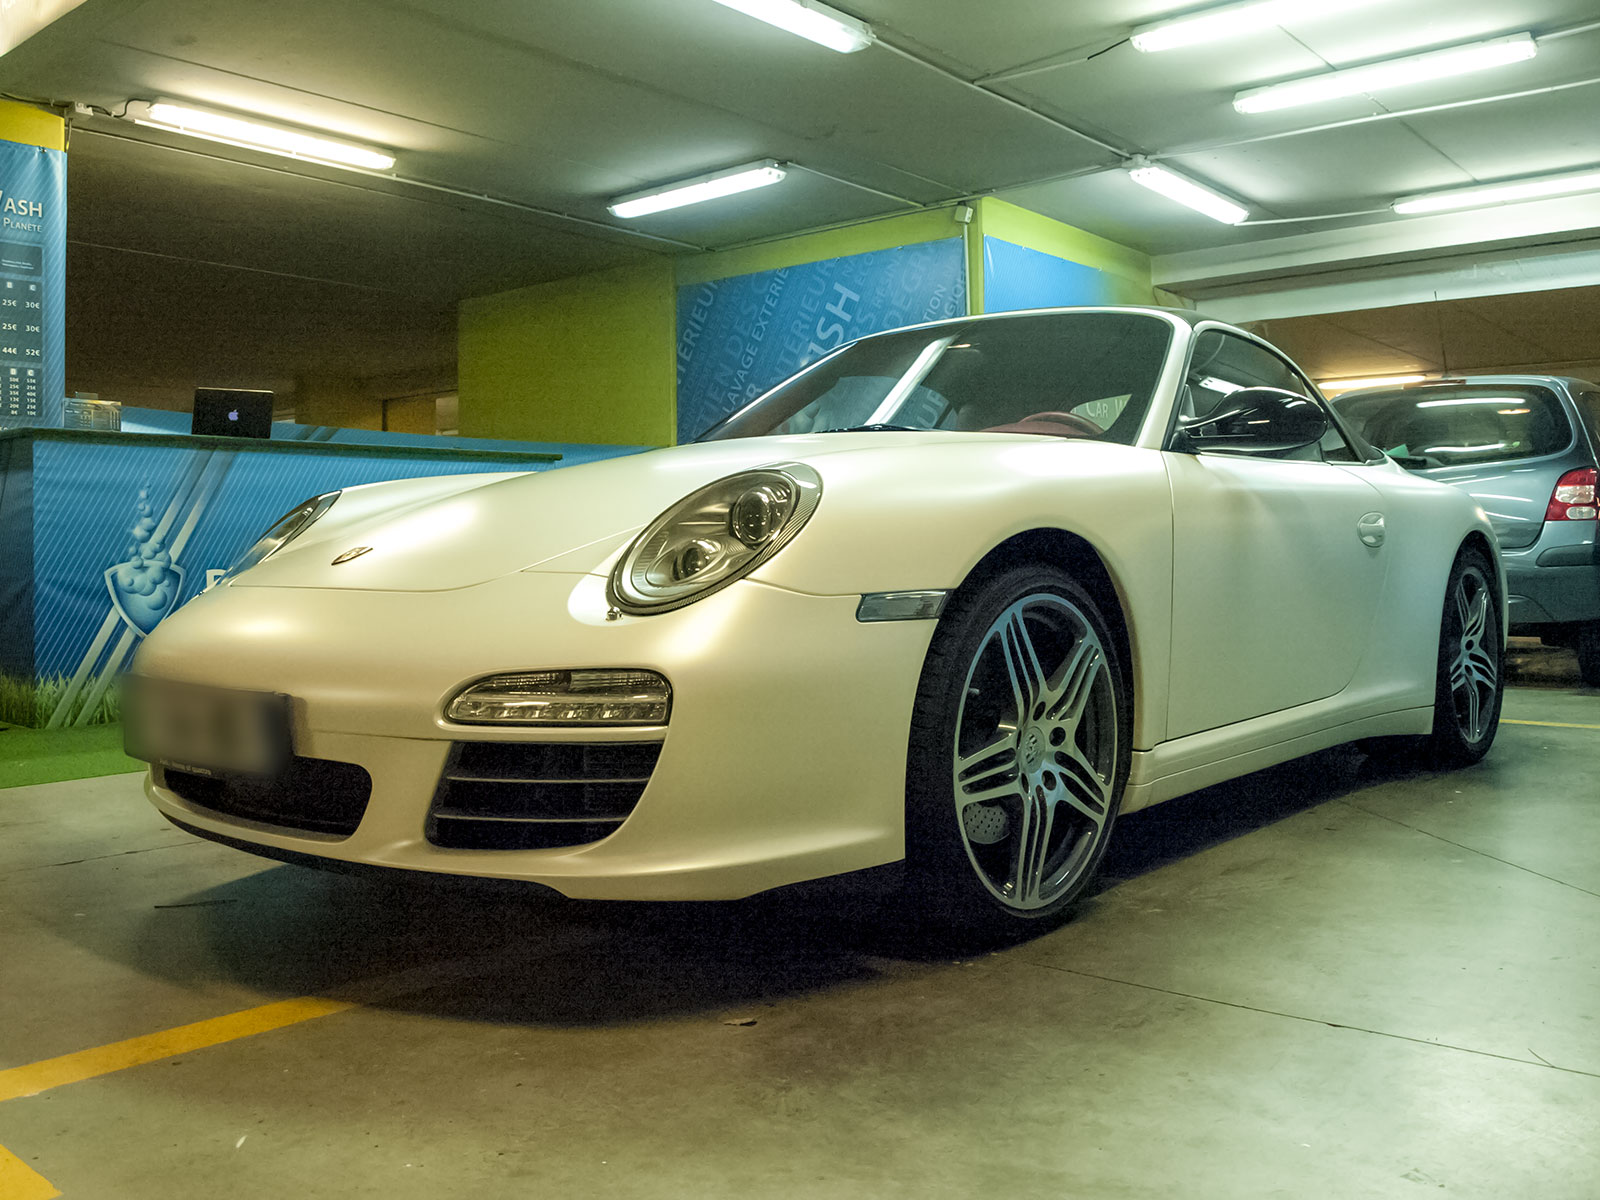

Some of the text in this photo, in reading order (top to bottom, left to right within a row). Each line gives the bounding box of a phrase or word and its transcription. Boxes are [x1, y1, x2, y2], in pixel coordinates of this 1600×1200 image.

[0, 190, 42, 217] ASH
[2, 299, 17, 307] 25€
[2, 323, 17, 331] 25€
[2, 347, 17, 355] 44€
[722, 342, 758, 413] LAVAGE
